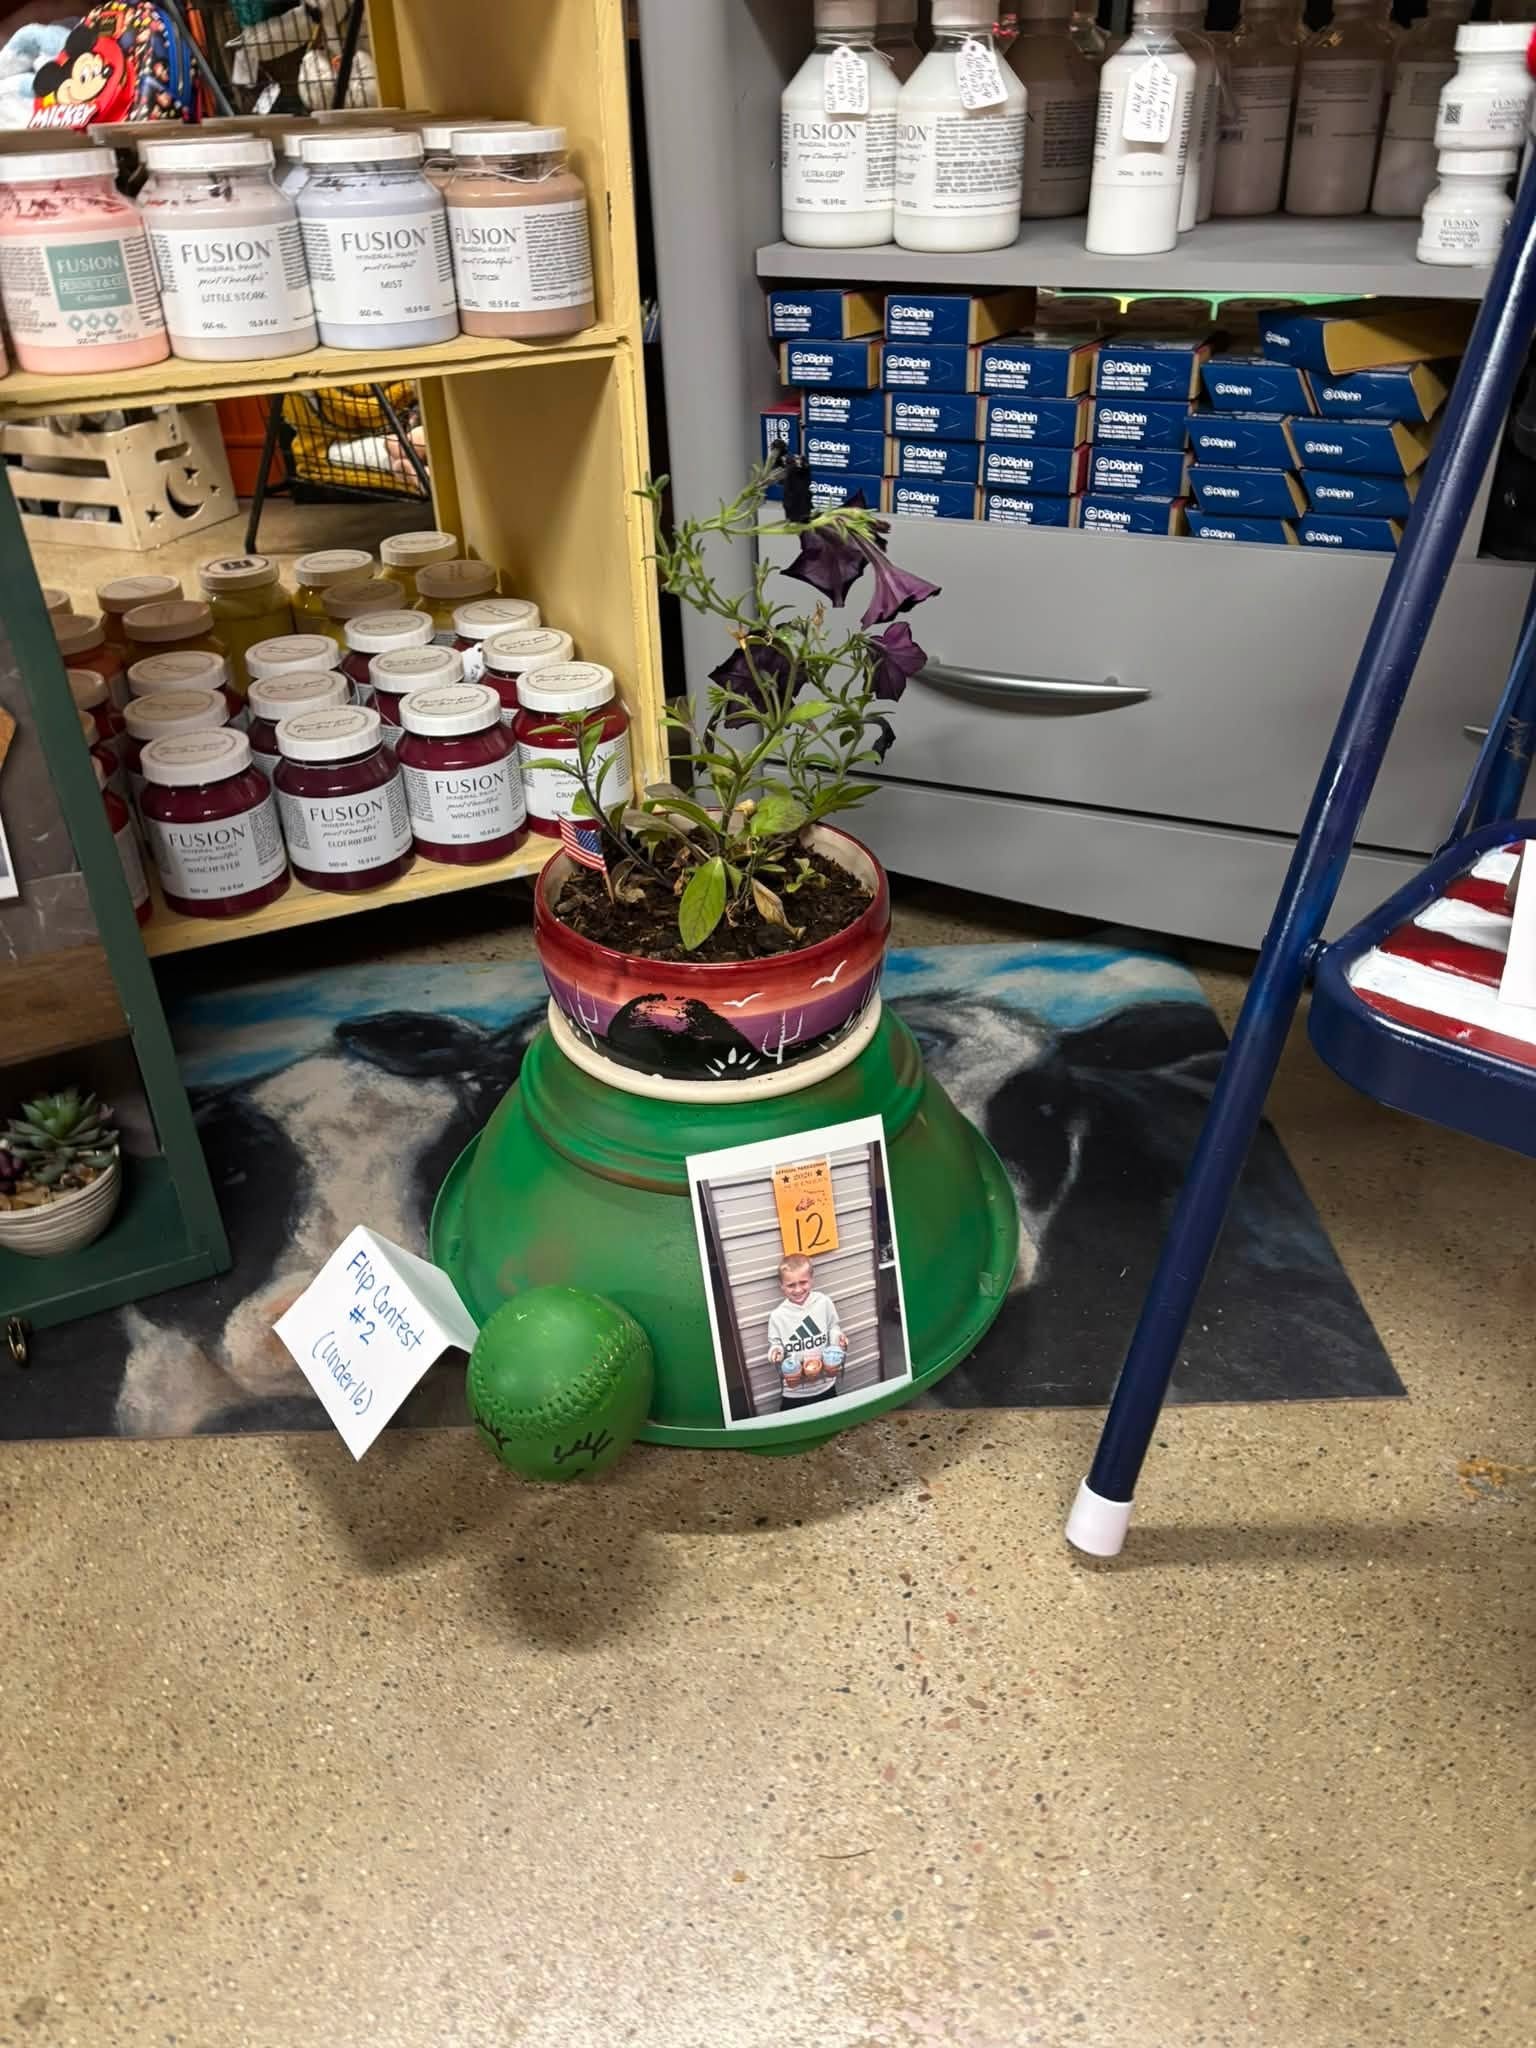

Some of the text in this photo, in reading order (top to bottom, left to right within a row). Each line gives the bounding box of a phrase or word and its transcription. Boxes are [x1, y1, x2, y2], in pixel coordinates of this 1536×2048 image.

[28, 104, 97, 128] MICKEY
[793, 123, 857, 139] FUSION
[341, 229, 427, 252] FUSION
[455, 226, 518, 245] FUSION
[181, 240, 272, 264] FUSION
[56, 255, 121, 273] FUSION
[380, 280, 403, 289] MIST
[435, 772, 505, 794] FUSION
[310, 800, 383, 822] FUSION
[450, 806, 500, 820] WINCHESTER
[168, 826, 246, 848] FUSION
[328, 835, 377, 848] ELDERBERRY
[187, 861, 241, 874] WINCHESTER
[796, 1212, 831, 1252] 12
[346, 1250, 425, 1352] Flip Contest
[785, 1334, 827, 1353] adidas
